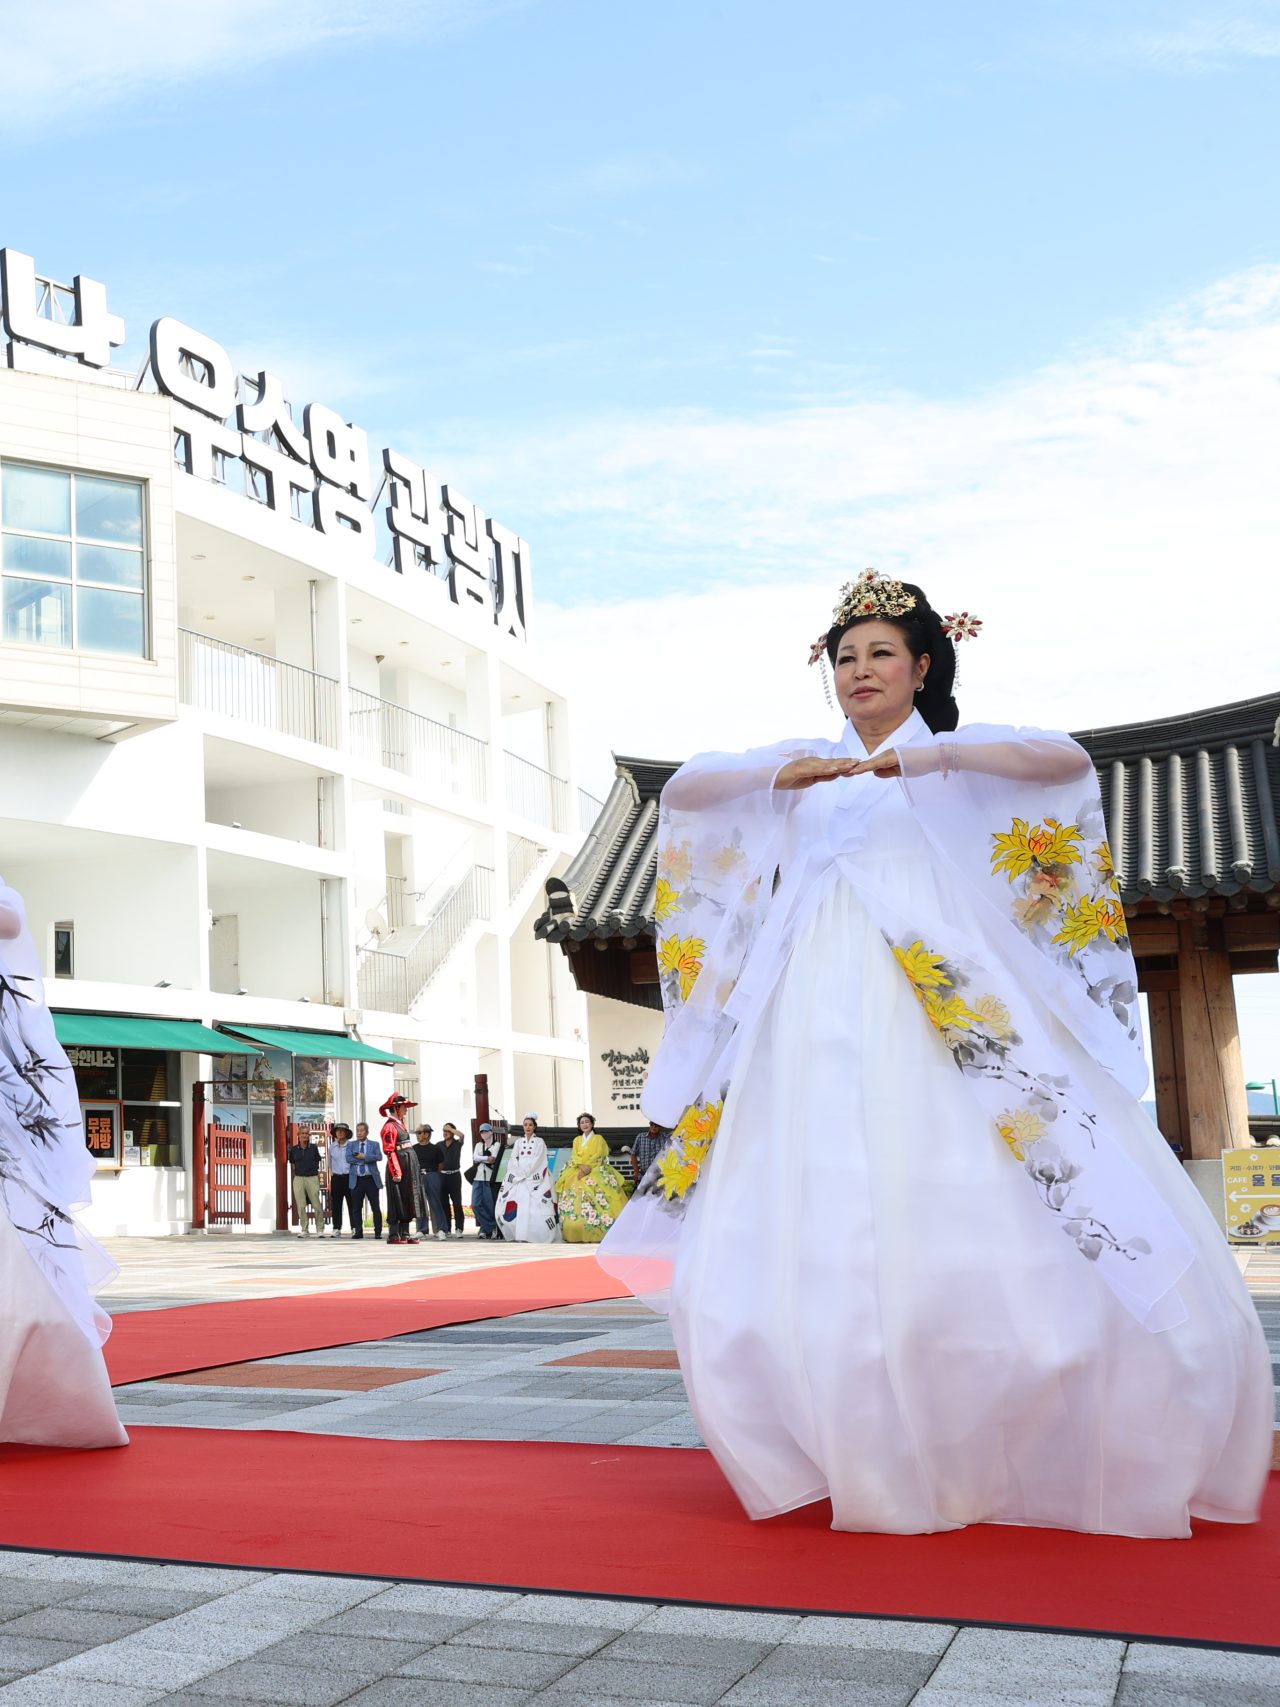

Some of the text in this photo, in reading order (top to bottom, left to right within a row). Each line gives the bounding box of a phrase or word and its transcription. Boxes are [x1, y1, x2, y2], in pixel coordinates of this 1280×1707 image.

[149, 316, 377, 556] 우수영
[382, 447, 532, 646] 관광지
[88, 1117, 112, 1133] 무료
[88, 1133, 112, 1150] 개방
[1226, 1176, 1248, 1184] CAFE
